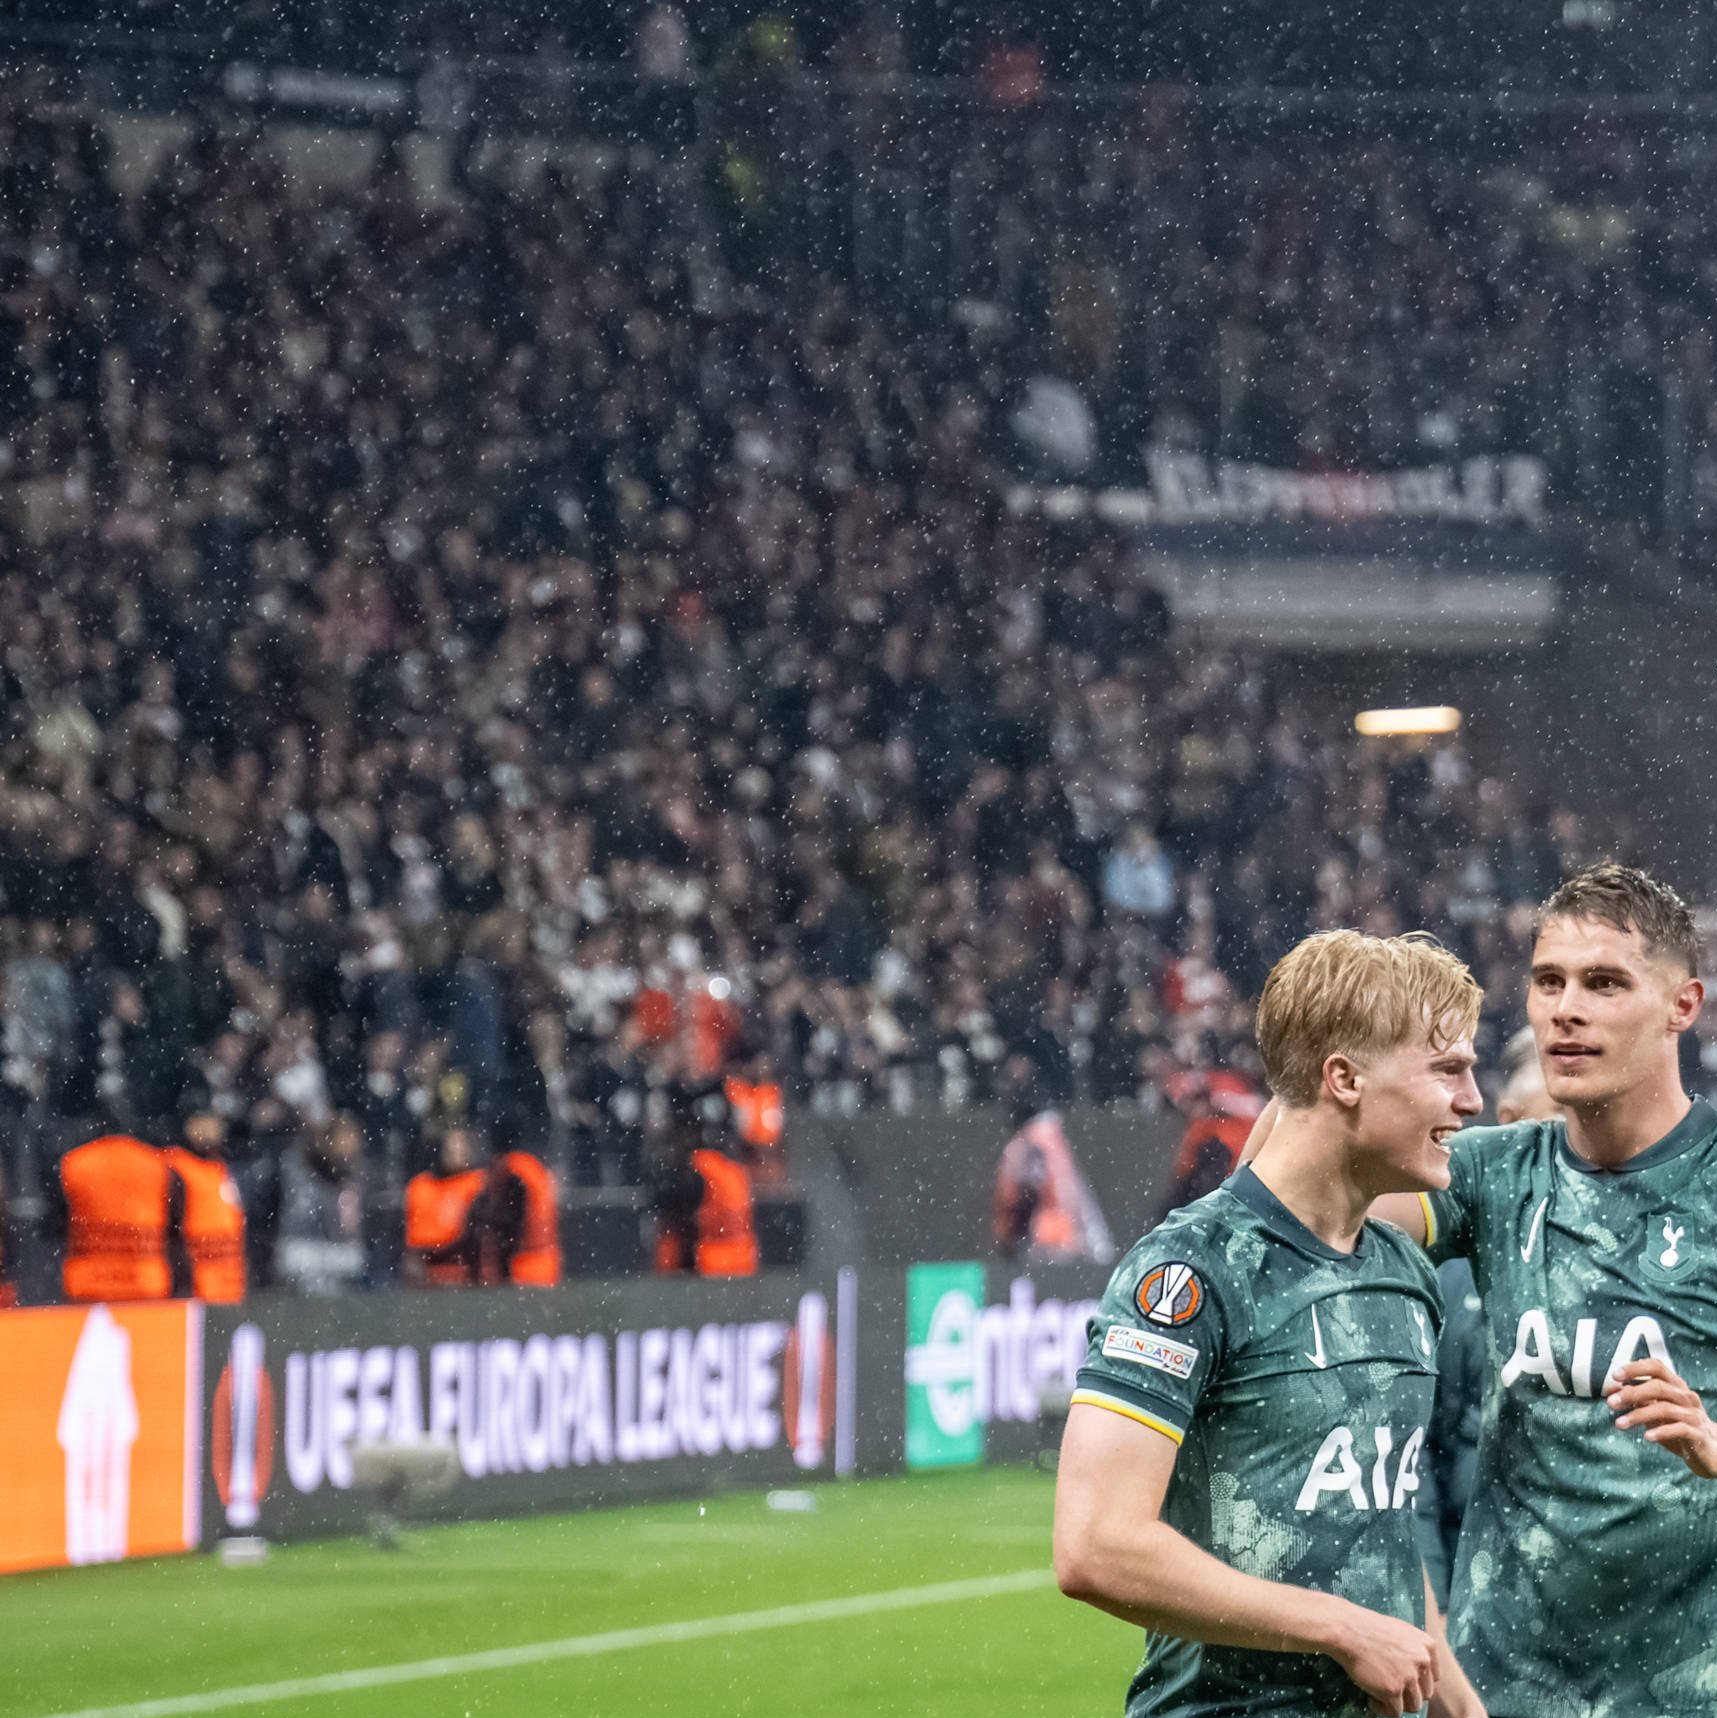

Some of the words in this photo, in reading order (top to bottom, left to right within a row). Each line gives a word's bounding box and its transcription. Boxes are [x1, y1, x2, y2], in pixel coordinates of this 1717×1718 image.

[1500, 1309, 1677, 1398] AIA
[285, 1346, 423, 1490] UEFA
[429, 1333, 612, 1478] EUROPA
[615, 1320, 788, 1463] LEAGUE
[1294, 1426, 1424, 1511] AIA
